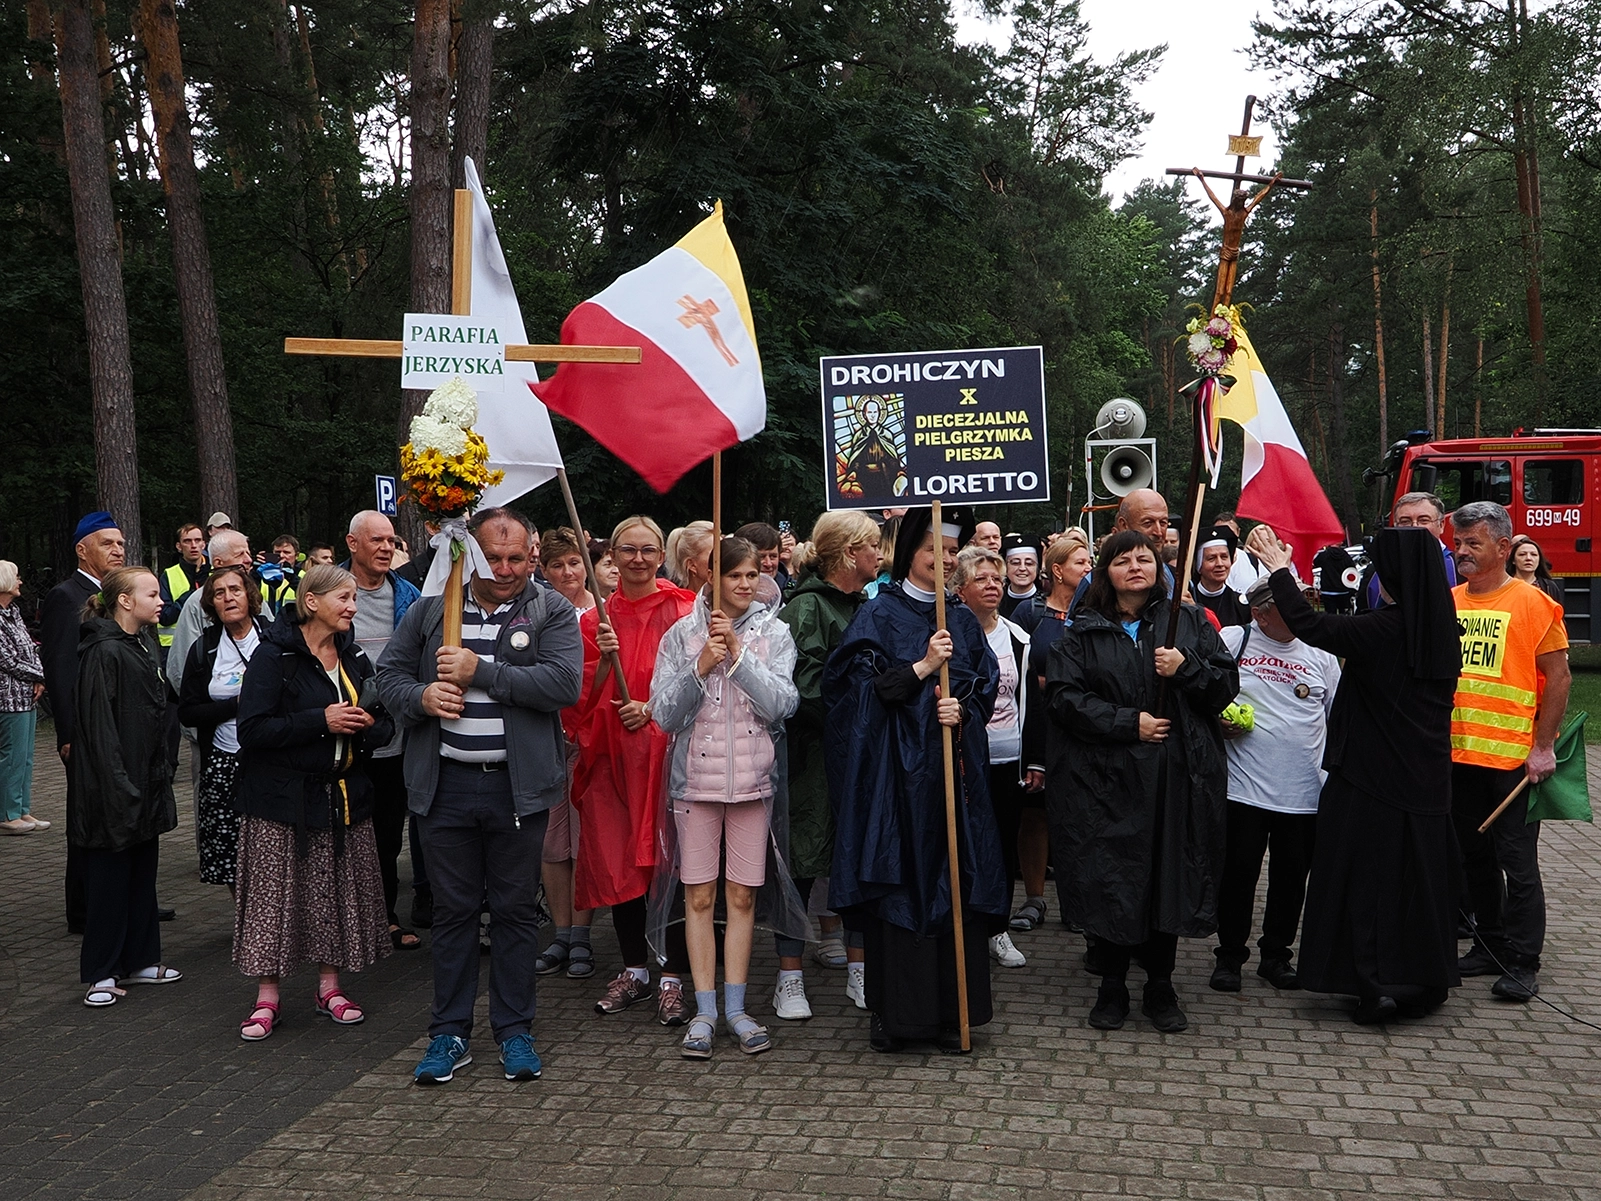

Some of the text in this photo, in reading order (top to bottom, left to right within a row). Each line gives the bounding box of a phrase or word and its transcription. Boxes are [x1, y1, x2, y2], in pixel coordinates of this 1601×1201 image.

[411, 325, 500, 345] PARAFIA
[404, 355, 504, 376] JERZYSKA
[830, 358, 1006, 386] DROHICZYN
[959, 388, 978, 406] X
[915, 410, 1029, 429] DIECEZJALNA
[914, 427, 1033, 446] PIELGRZYMKA
[945, 446, 1005, 462] PIESZA
[913, 471, 1039, 496] LORETTO
[380, 480, 393, 511] P
